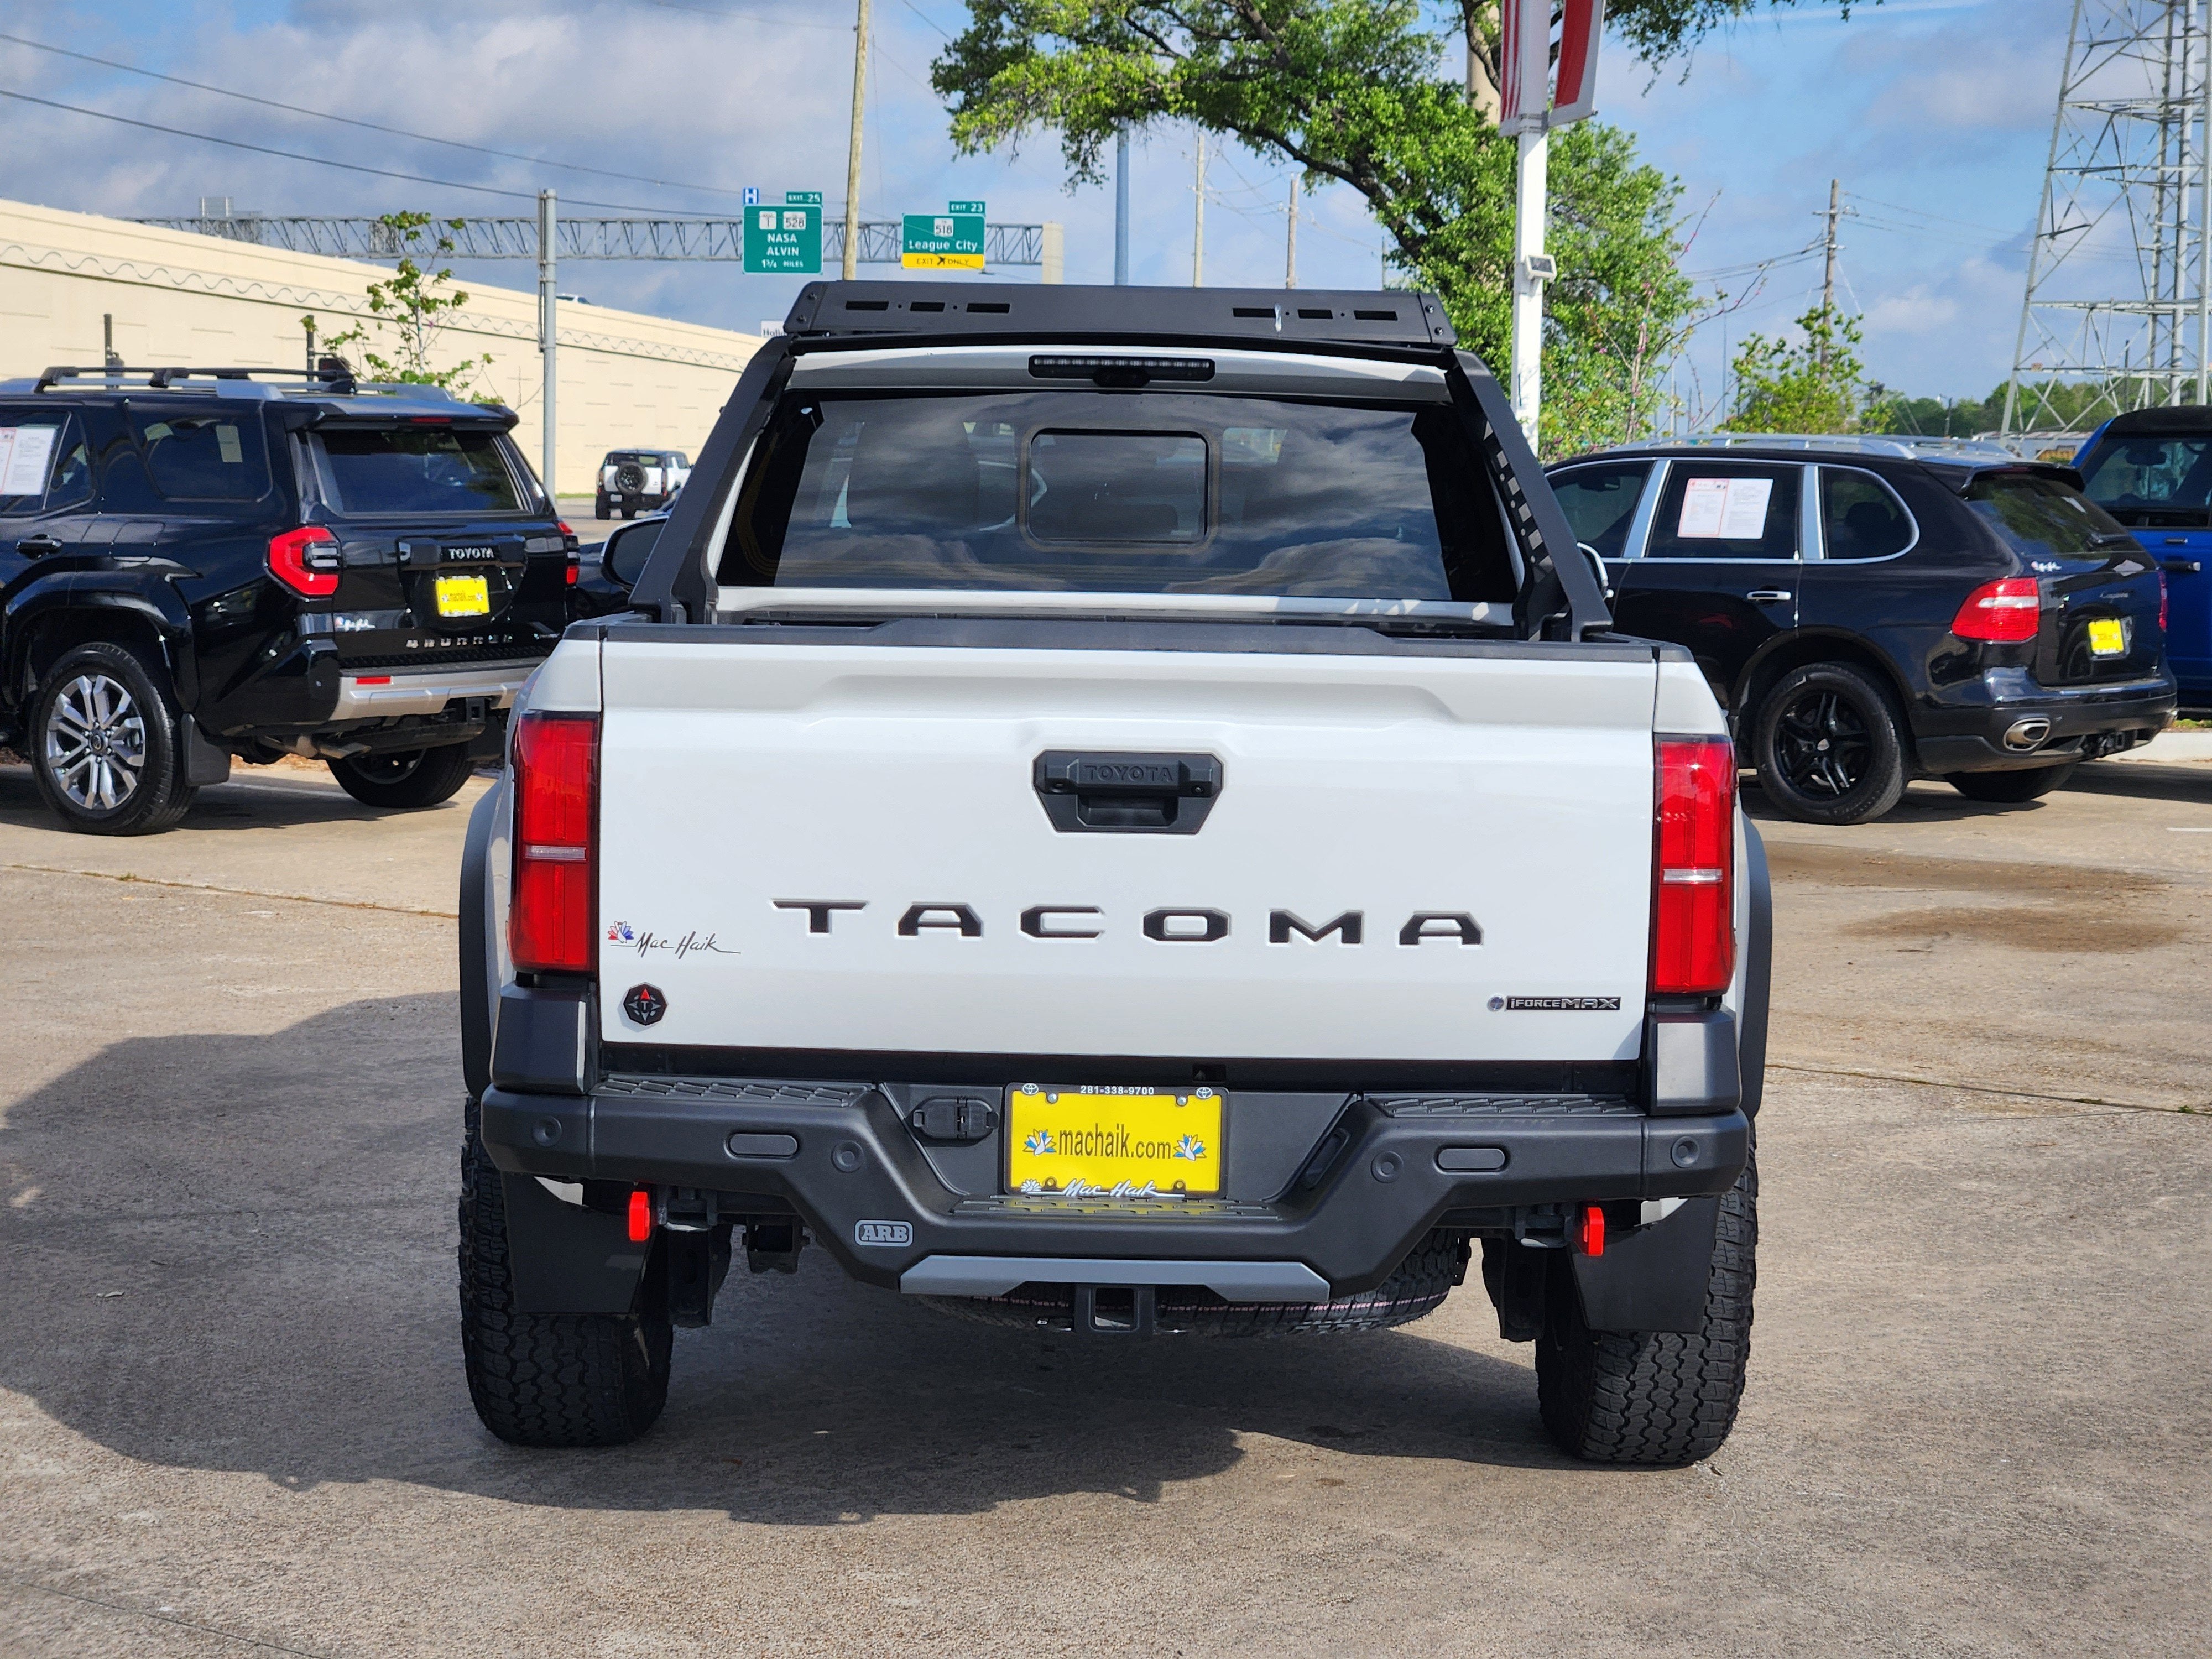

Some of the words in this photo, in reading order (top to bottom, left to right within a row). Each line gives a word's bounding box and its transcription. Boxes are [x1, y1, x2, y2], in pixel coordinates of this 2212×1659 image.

[808, 194, 820, 202] 25
[971, 203, 983, 212] 23
[786, 218, 805, 227] 528
[936, 225, 952, 234] 518
[767, 233, 797, 243] NASA
[766, 246, 799, 256] ALVIN
[909, 239, 950, 252] League
[956, 239, 978, 252] City
[448, 547, 494, 559] TOYOTA
[1084, 765, 1173, 782] TOYOTA
[771, 899, 1486, 947] TACOMA
[636, 932, 674, 958] Mac
[674, 931, 741, 960] Haik
[1081, 1086, 1154, 1095] 281-338-9700
[1058, 1123, 1171, 1159] machaik.com
[1061, 1178, 1108, 1197] Mac
[1109, 1180, 1185, 1197] Haik
[861, 1225, 907, 1241] ARB
